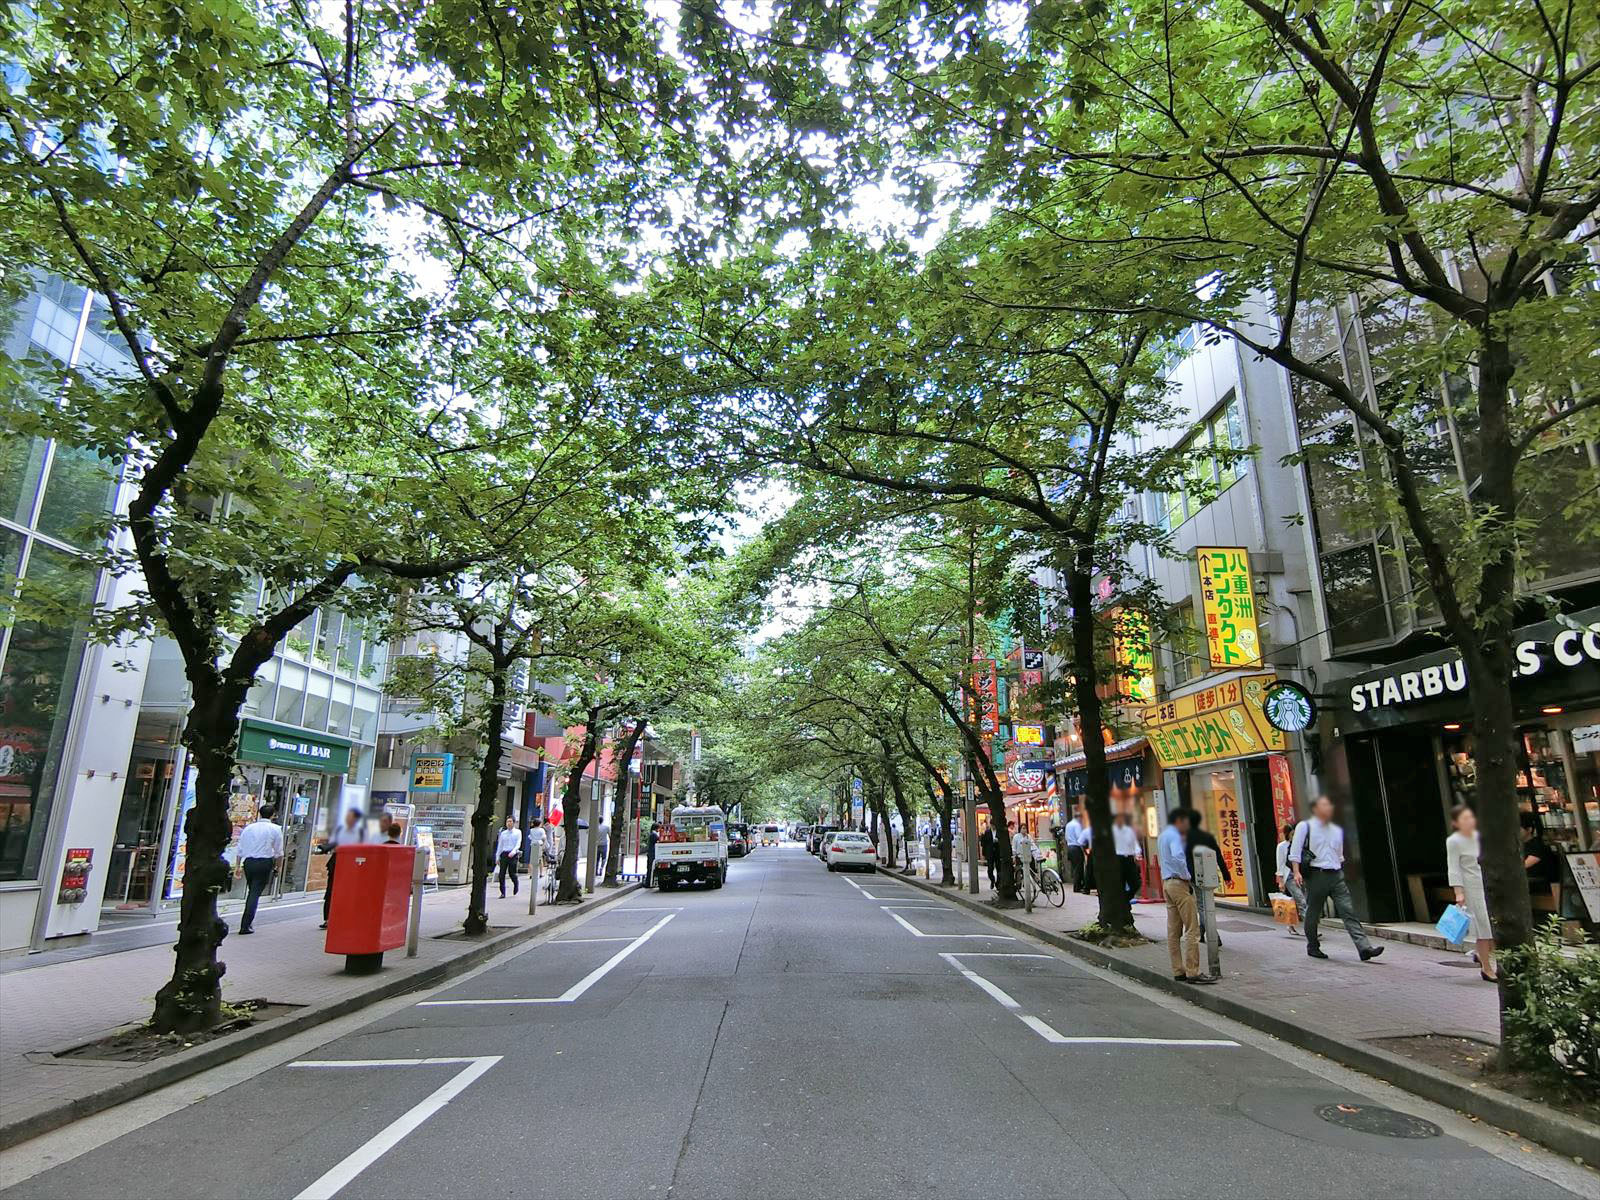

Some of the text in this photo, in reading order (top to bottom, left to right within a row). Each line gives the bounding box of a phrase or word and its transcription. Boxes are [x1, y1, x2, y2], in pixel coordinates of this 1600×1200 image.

[1202, 576, 1214, 601] 本店
[1211, 553, 1240, 665] コンタクト
[1230, 553, 1253, 618] 八重洲
[1350, 640, 1541, 712] STARBUS
[311, 745, 331, 758] BAR
[1150, 718, 1232, 762] 八重洲コンタクト
[1219, 811, 1230, 847] まっすぐ
[1228, 810, 1243, 876] 本店はこのさき
